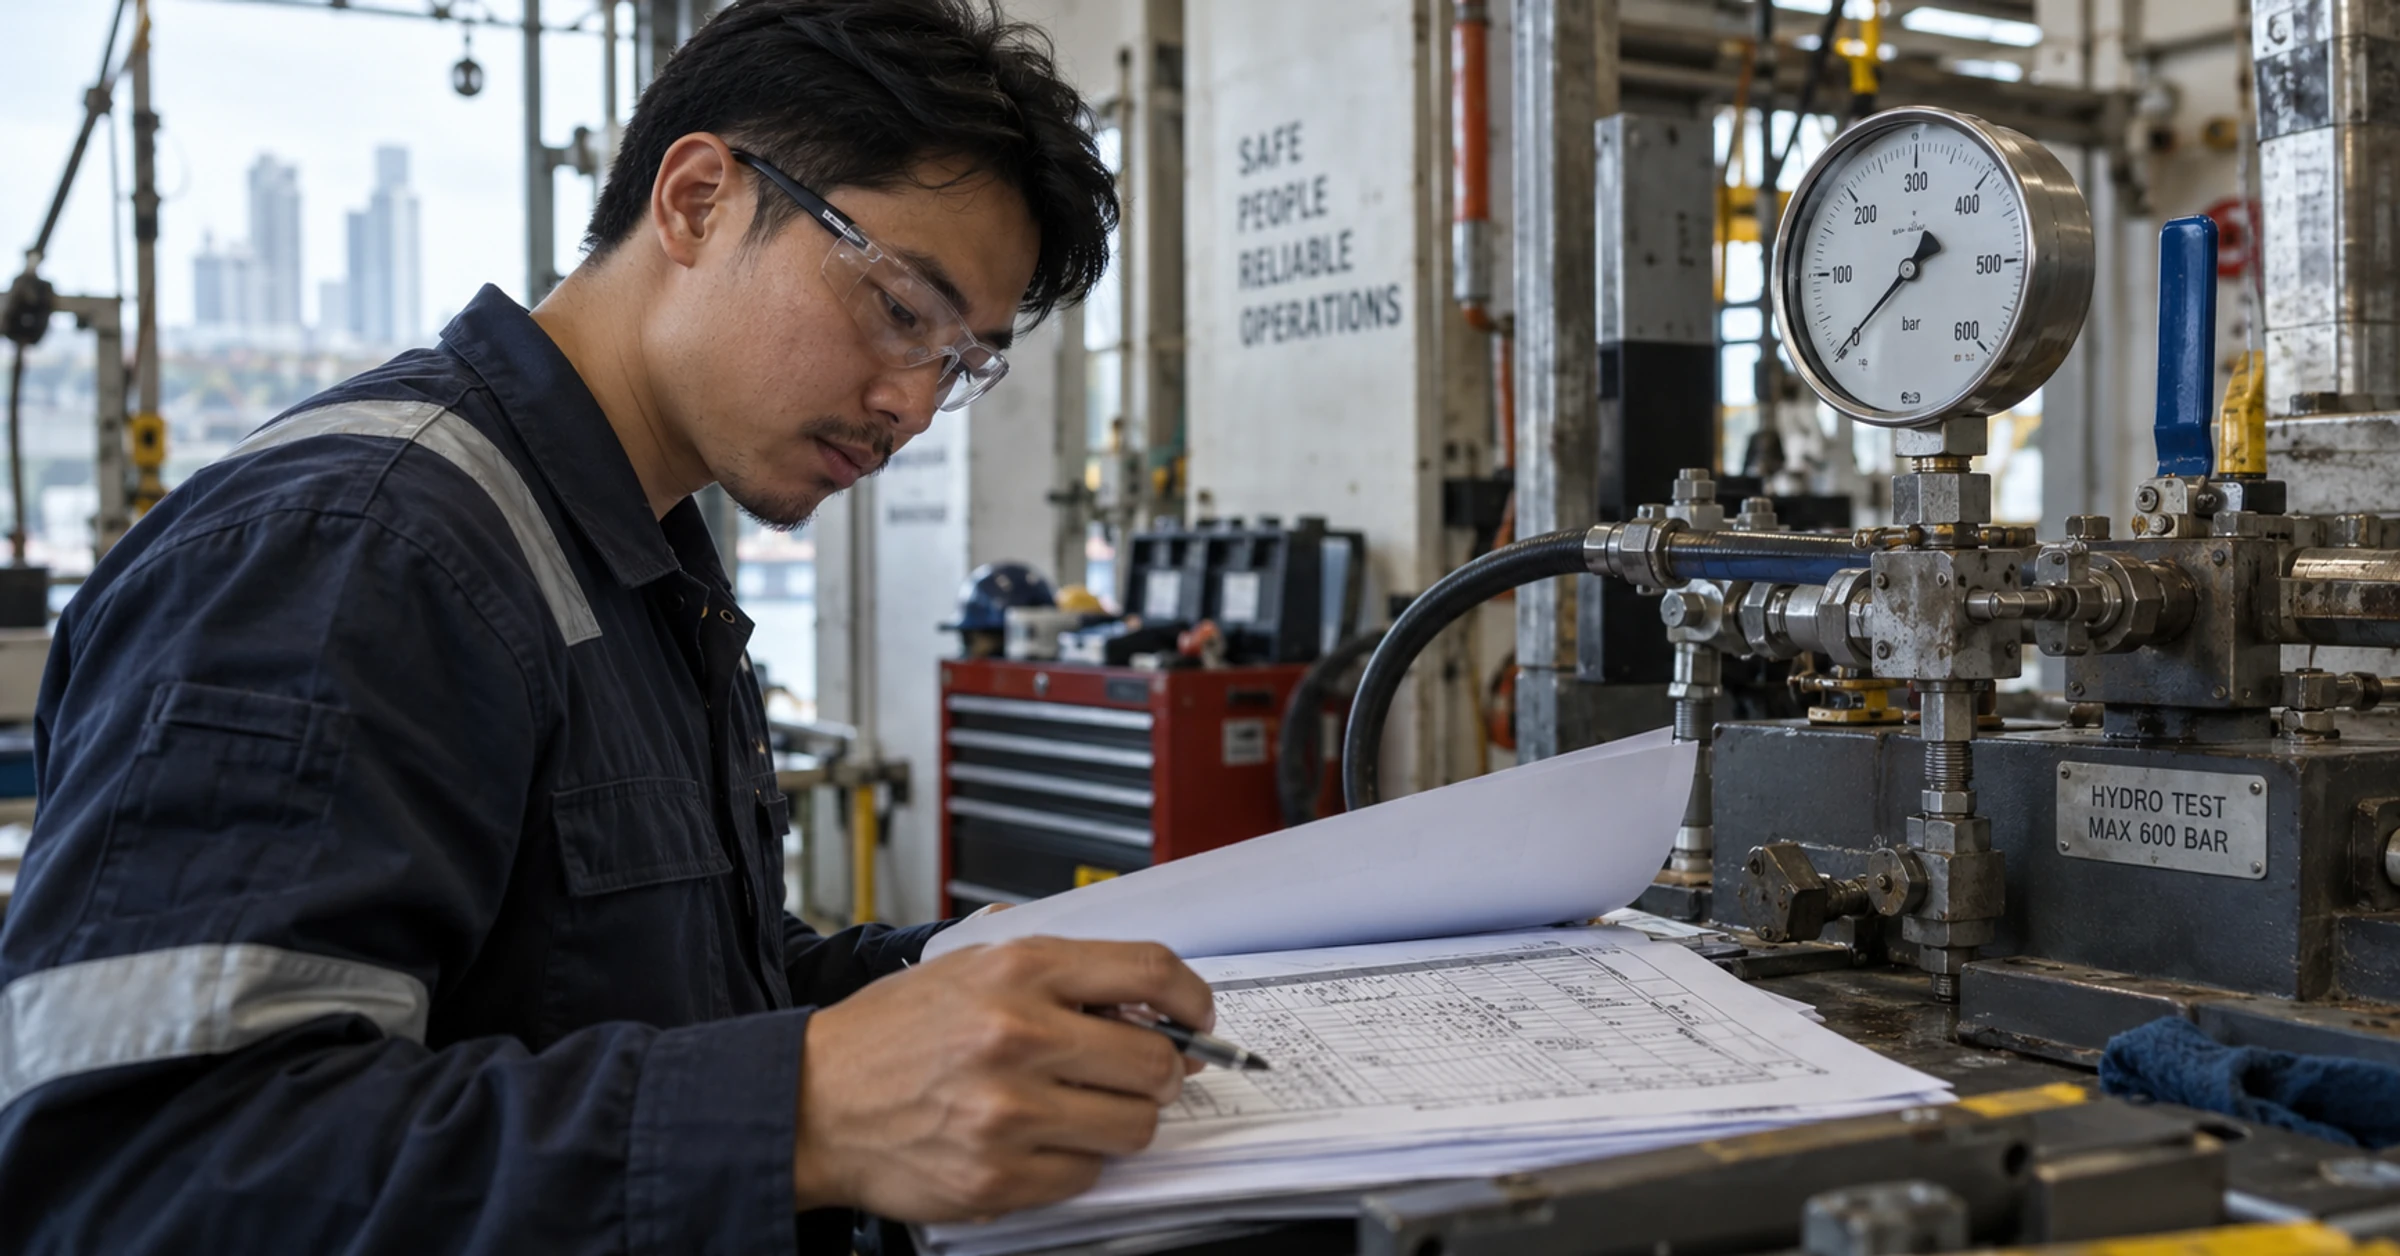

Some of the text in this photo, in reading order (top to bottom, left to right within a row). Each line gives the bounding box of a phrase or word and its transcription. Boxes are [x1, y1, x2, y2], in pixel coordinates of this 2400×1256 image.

[1239, 121, 1302, 175] SAFE
[1904, 171, 1928, 193] 300
[1238, 175, 1327, 232] PEOPLE
[1954, 194, 1980, 215] 400
[1854, 204, 1877, 225] 200
[1239, 230, 1352, 289] RELIABLE
[1976, 254, 2001, 275] 500
[1832, 265, 1852, 284] 100
[1241, 284, 1401, 346] OPERATIONS
[1902, 316, 1921, 331] bar
[1851, 326, 1860, 346] 0
[1954, 320, 1979, 341] 600
[2091, 785, 2226, 819] HYDRO TEST
[2088, 816, 2228, 854] MAX 600 BAR
